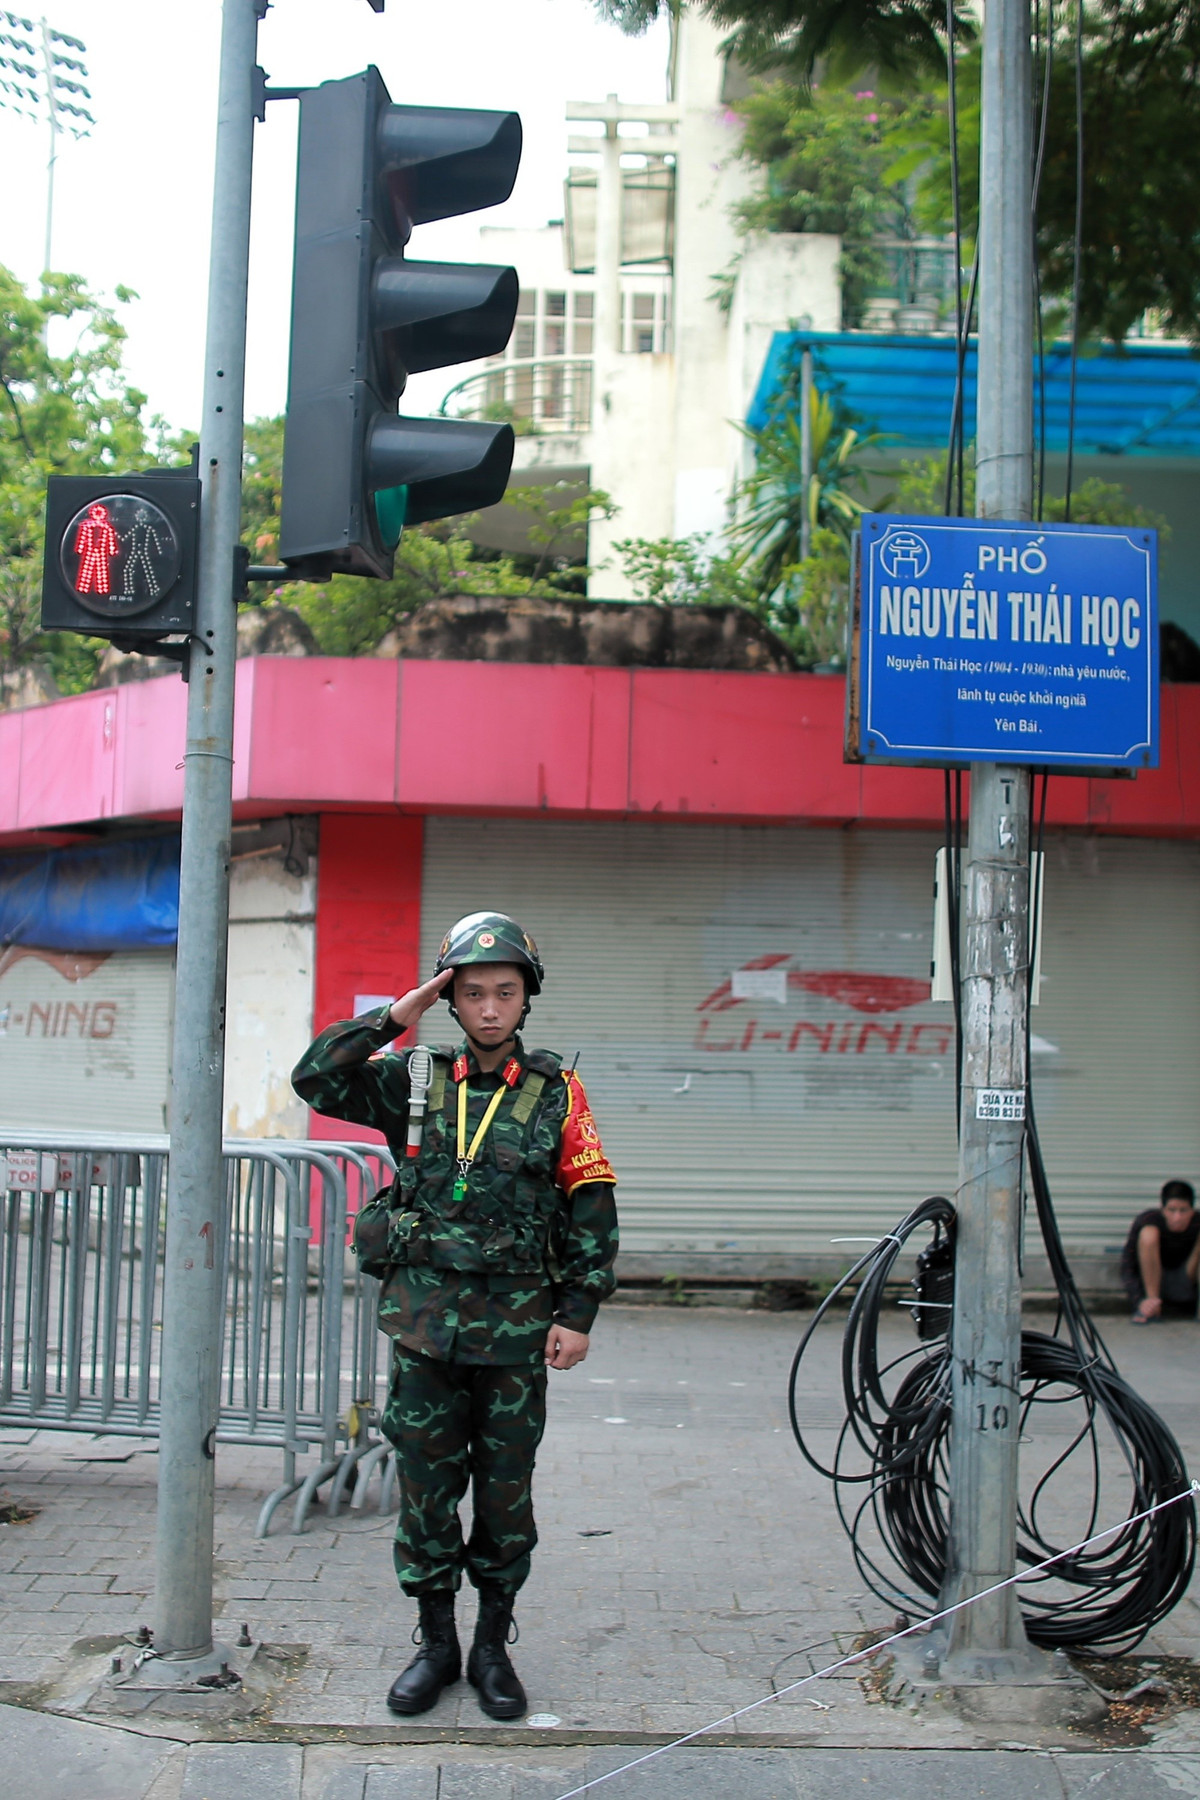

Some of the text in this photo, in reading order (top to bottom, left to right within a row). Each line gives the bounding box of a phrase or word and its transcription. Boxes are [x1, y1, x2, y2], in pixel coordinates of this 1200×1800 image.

[978, 536, 1048, 575] PHỐ
[879, 572, 1141, 656] NGUYỄN THÁI HỌC
[886, 653, 930, 672] Nguyễn
[932, 656, 958, 671] Thái
[959, 659, 982, 674] Học
[1053, 663, 1075, 677] nhà
[1077, 664, 1097, 682] yêu
[957, 687, 983, 701] lãnh
[985, 689, 997, 704] tụ
[998, 690, 1027, 706] cuộc
[1029, 688, 1054, 705] khởi
[994, 717, 1017, 732] Yên
[694, 1018, 954, 1056] LI-NING
[9, 1157, 37, 1166] OLICE
[976, 1403, 1008, 1432] 10
